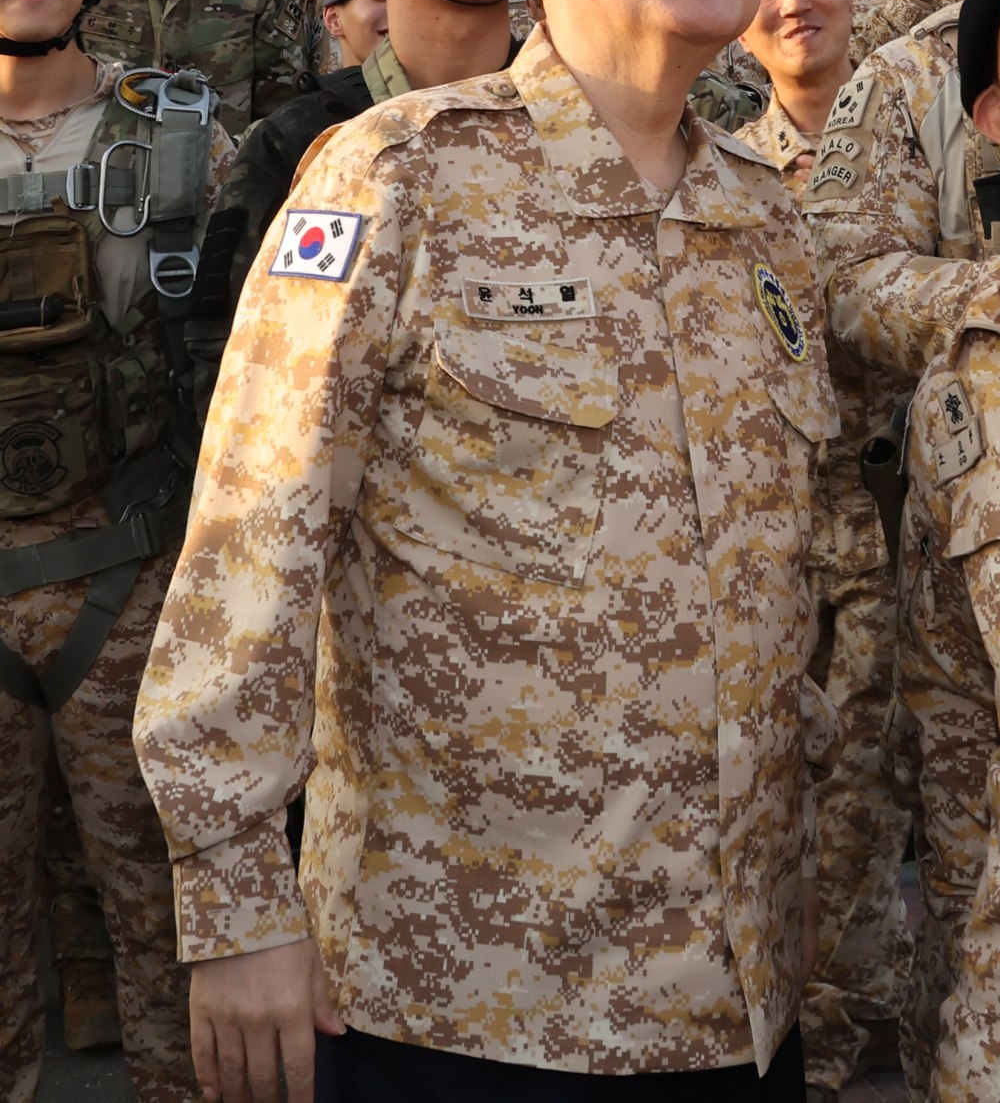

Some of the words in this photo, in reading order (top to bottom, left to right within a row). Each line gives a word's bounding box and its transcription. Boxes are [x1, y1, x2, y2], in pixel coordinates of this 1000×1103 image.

[827, 116, 855, 129] KOREA
[820, 137, 855, 157] HALO
[812, 165, 852, 186] RANGER
[512, 305, 544, 315] YOON
